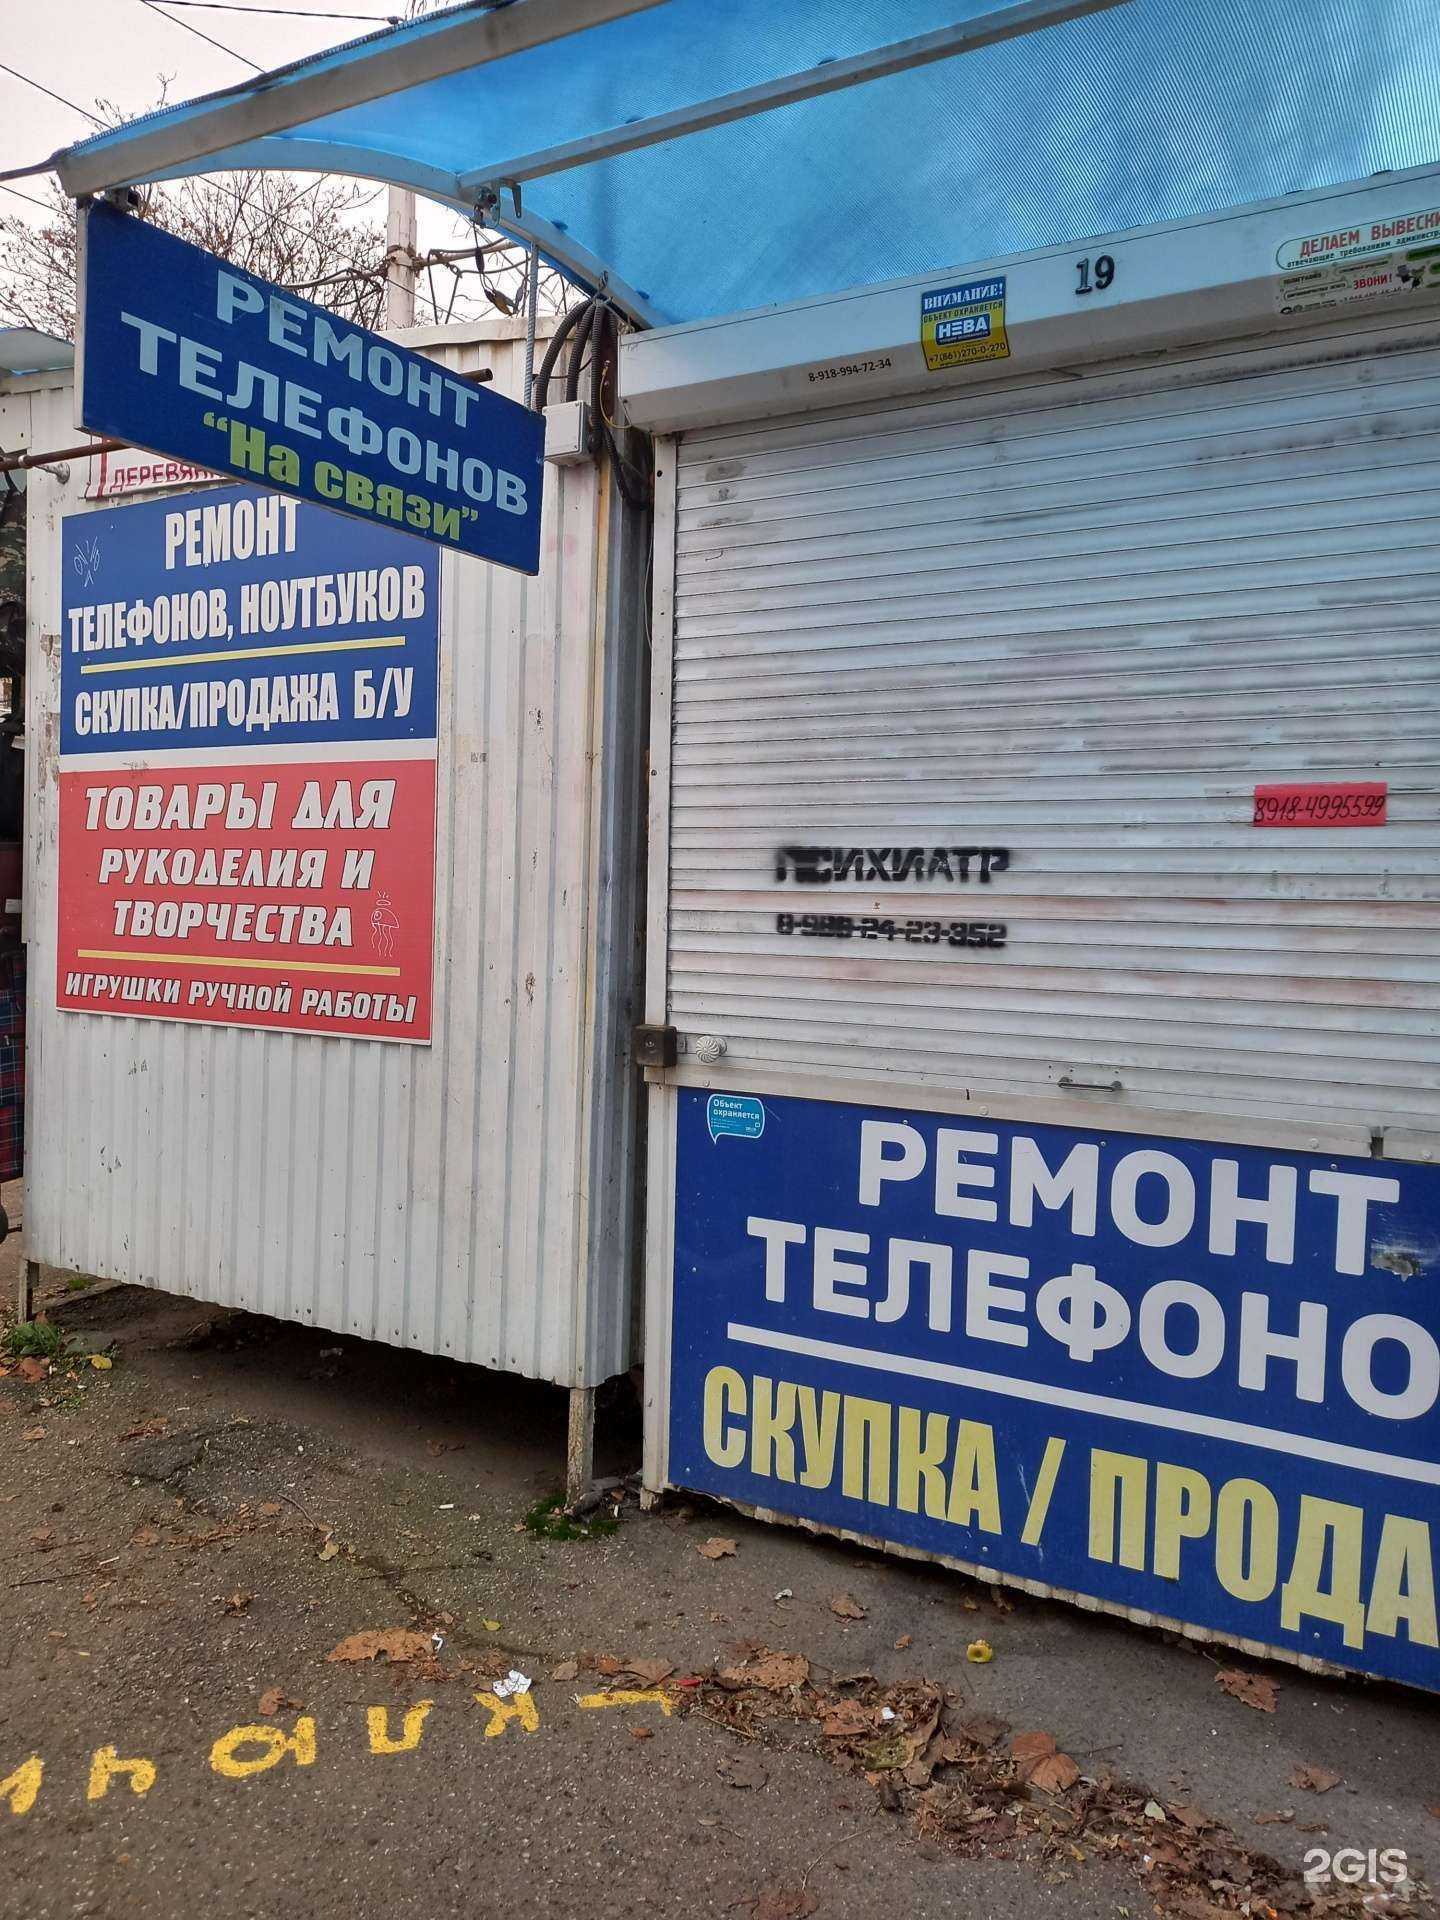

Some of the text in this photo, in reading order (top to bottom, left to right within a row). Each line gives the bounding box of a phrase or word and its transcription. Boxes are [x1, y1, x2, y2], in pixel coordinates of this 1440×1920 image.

[1300, 230, 1360, 257] ДЕЛАЕМ
[1075, 255, 1115, 295] 19
[1353, 273, 1393, 290] ЗВОНИ!
[924, 283, 1003, 310] ВНИМАНИЕ!
[924, 301, 1003, 323] ОБЪЕКТ ОХРАНЯЕТСЯ
[939, 316, 988, 339] НЕВА
[216, 269, 480, 429] РЕМОНТ
[808, 358, 892, 382] 8-918-994-72-34
[121, 311, 528, 515] ТЕЛЕФОНОВ
[109, 462, 214, 493] ДЕРЕВЯН
[165, 494, 302, 570] РЕМОНТ
[69, 565, 425, 653] ТЕЛЕФОНОВ, НОУТБУКОВ
[75, 667, 414, 736] СКУПКА/ПРОДАЖА Б/У
[85, 779, 397, 831] ТОВАРЫ ДЛЯ
[1254, 794, 1386, 821] 8918-4995599
[98, 848, 376, 889] РУКОДЕЛИЯ И
[775, 846, 1010, 883] ПСИХИАТР
[113, 900, 354, 947] ТВОРЧЕСТВА
[64, 972, 417, 1023] ИГРУШКИ РУЧНОЙ РАБОТЫ
[713, 1099, 743, 1110] Объект
[713, 1108, 760, 1120] охраняется
[859, 1119, 1400, 1277] РЕМОНТ
[747, 1215, 1440, 1420] ТЕЛЕФОНО
[704, 1365, 1002, 1535] СКУПКА
[1088, 1448, 1439, 1650] ПРОДА
